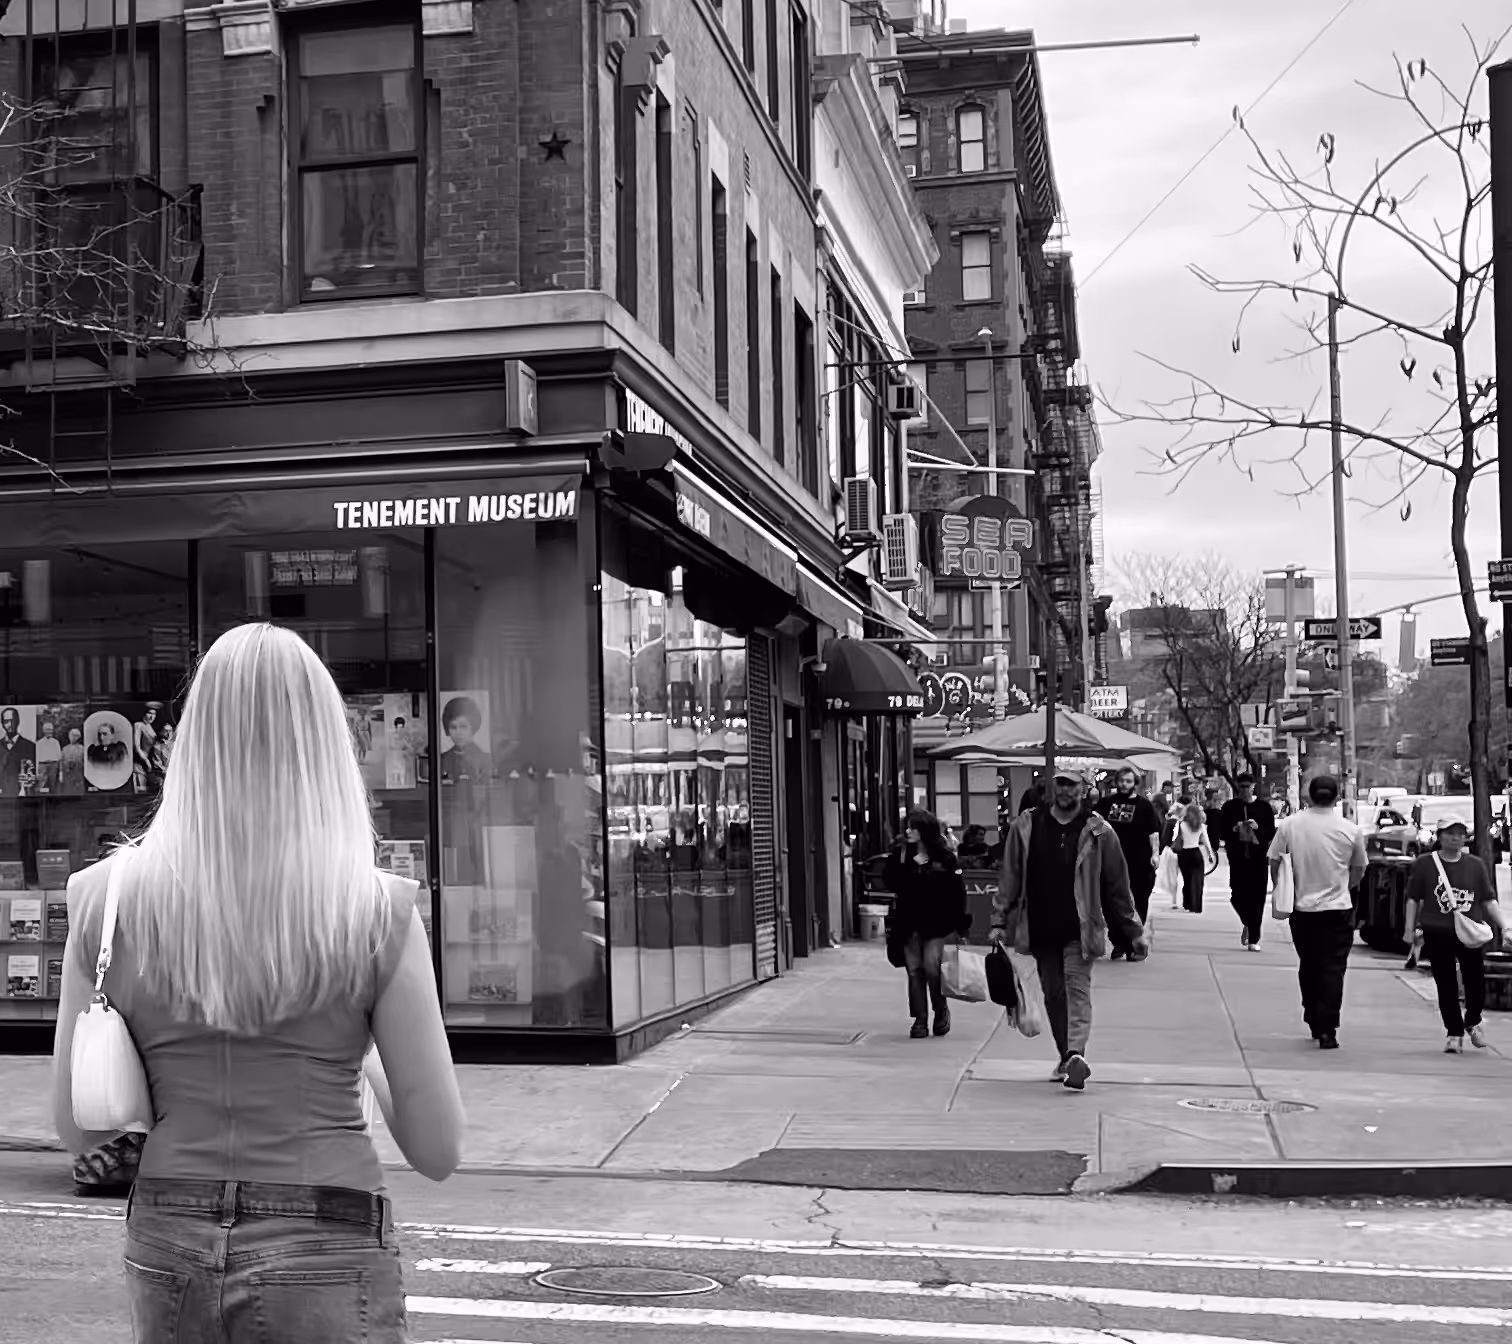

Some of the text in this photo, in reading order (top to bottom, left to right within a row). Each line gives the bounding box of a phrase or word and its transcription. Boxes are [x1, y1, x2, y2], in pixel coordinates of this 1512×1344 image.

[333, 489, 576, 529] TENEMENT MUSEUM
[941, 513, 1034, 549] SEA
[943, 547, 1022, 578] FOOD
[1091, 687, 1120, 697] ATM
